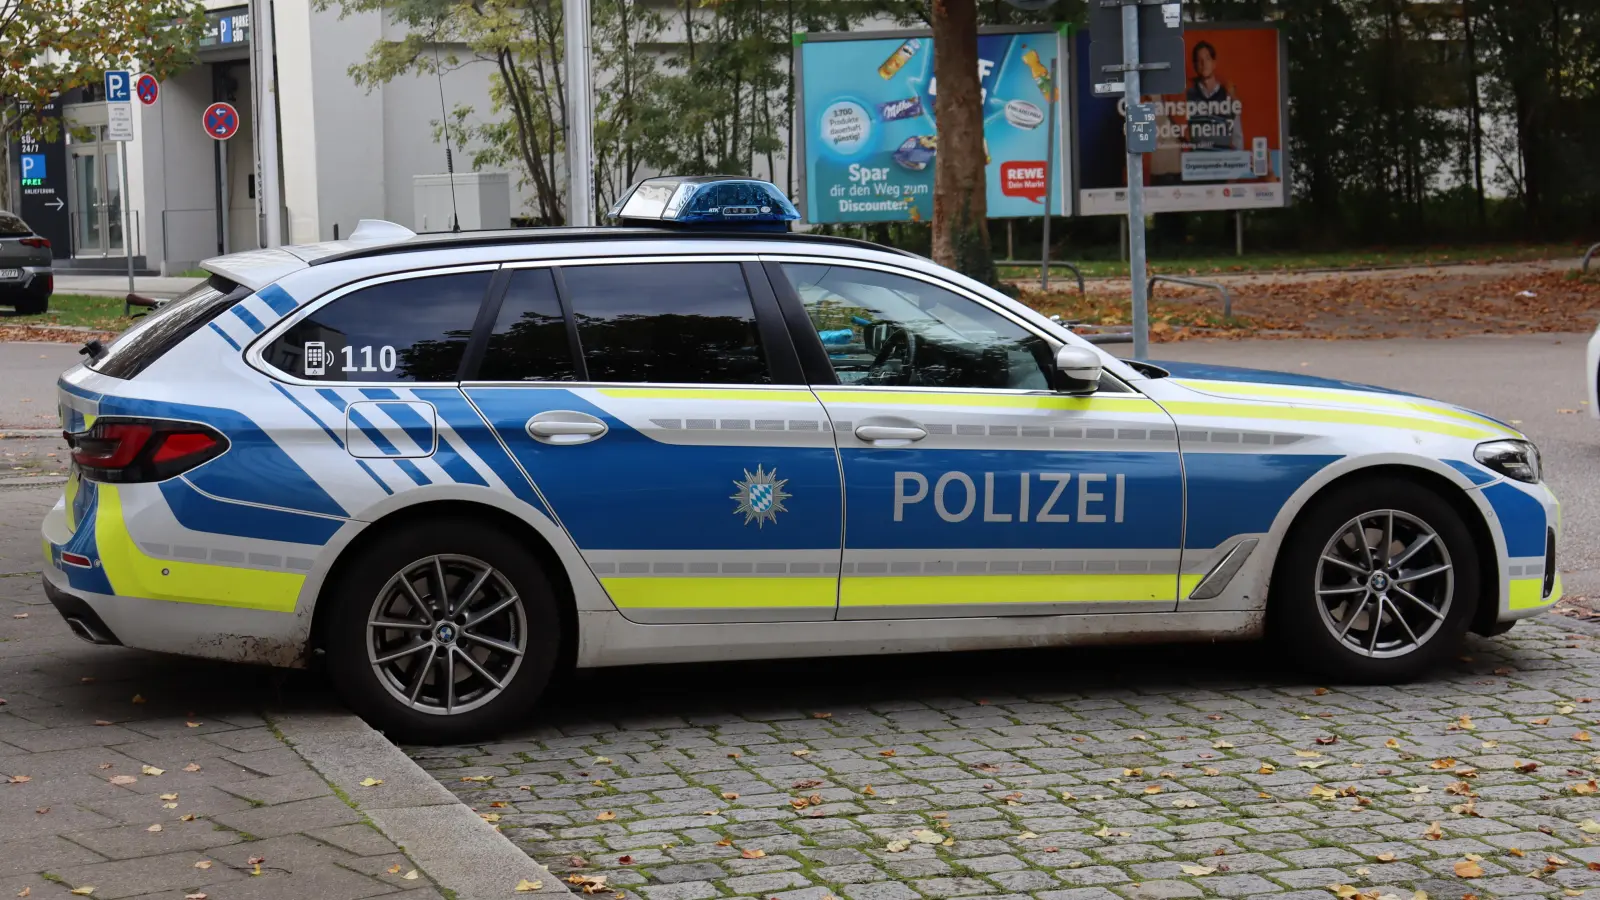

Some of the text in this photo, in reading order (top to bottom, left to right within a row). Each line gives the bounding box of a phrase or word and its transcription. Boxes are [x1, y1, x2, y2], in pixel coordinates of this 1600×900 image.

[232, 14, 248, 28] PARKE
[233, 27, 244, 43] SÜD
[109, 75, 123, 99] P
[883, 100, 913, 119] Milka
[1117, 96, 1242, 119] Oanspende
[829, 116, 860, 126] Produkte
[1191, 119, 1234, 137] nein?
[833, 132, 861, 145] günstig!
[1139, 133, 1149, 141] 5.0
[22, 144, 39, 153] 24/7
[848, 163, 890, 185] Spar
[1007, 168, 1045, 180] REWE
[21, 178, 42, 186] FREI
[1008, 180, 1045, 189] Dein Markt
[830, 183, 929, 198] dir den Weg zum
[341, 345, 397, 372] 110
[893, 471, 1126, 523] POLIZEI
